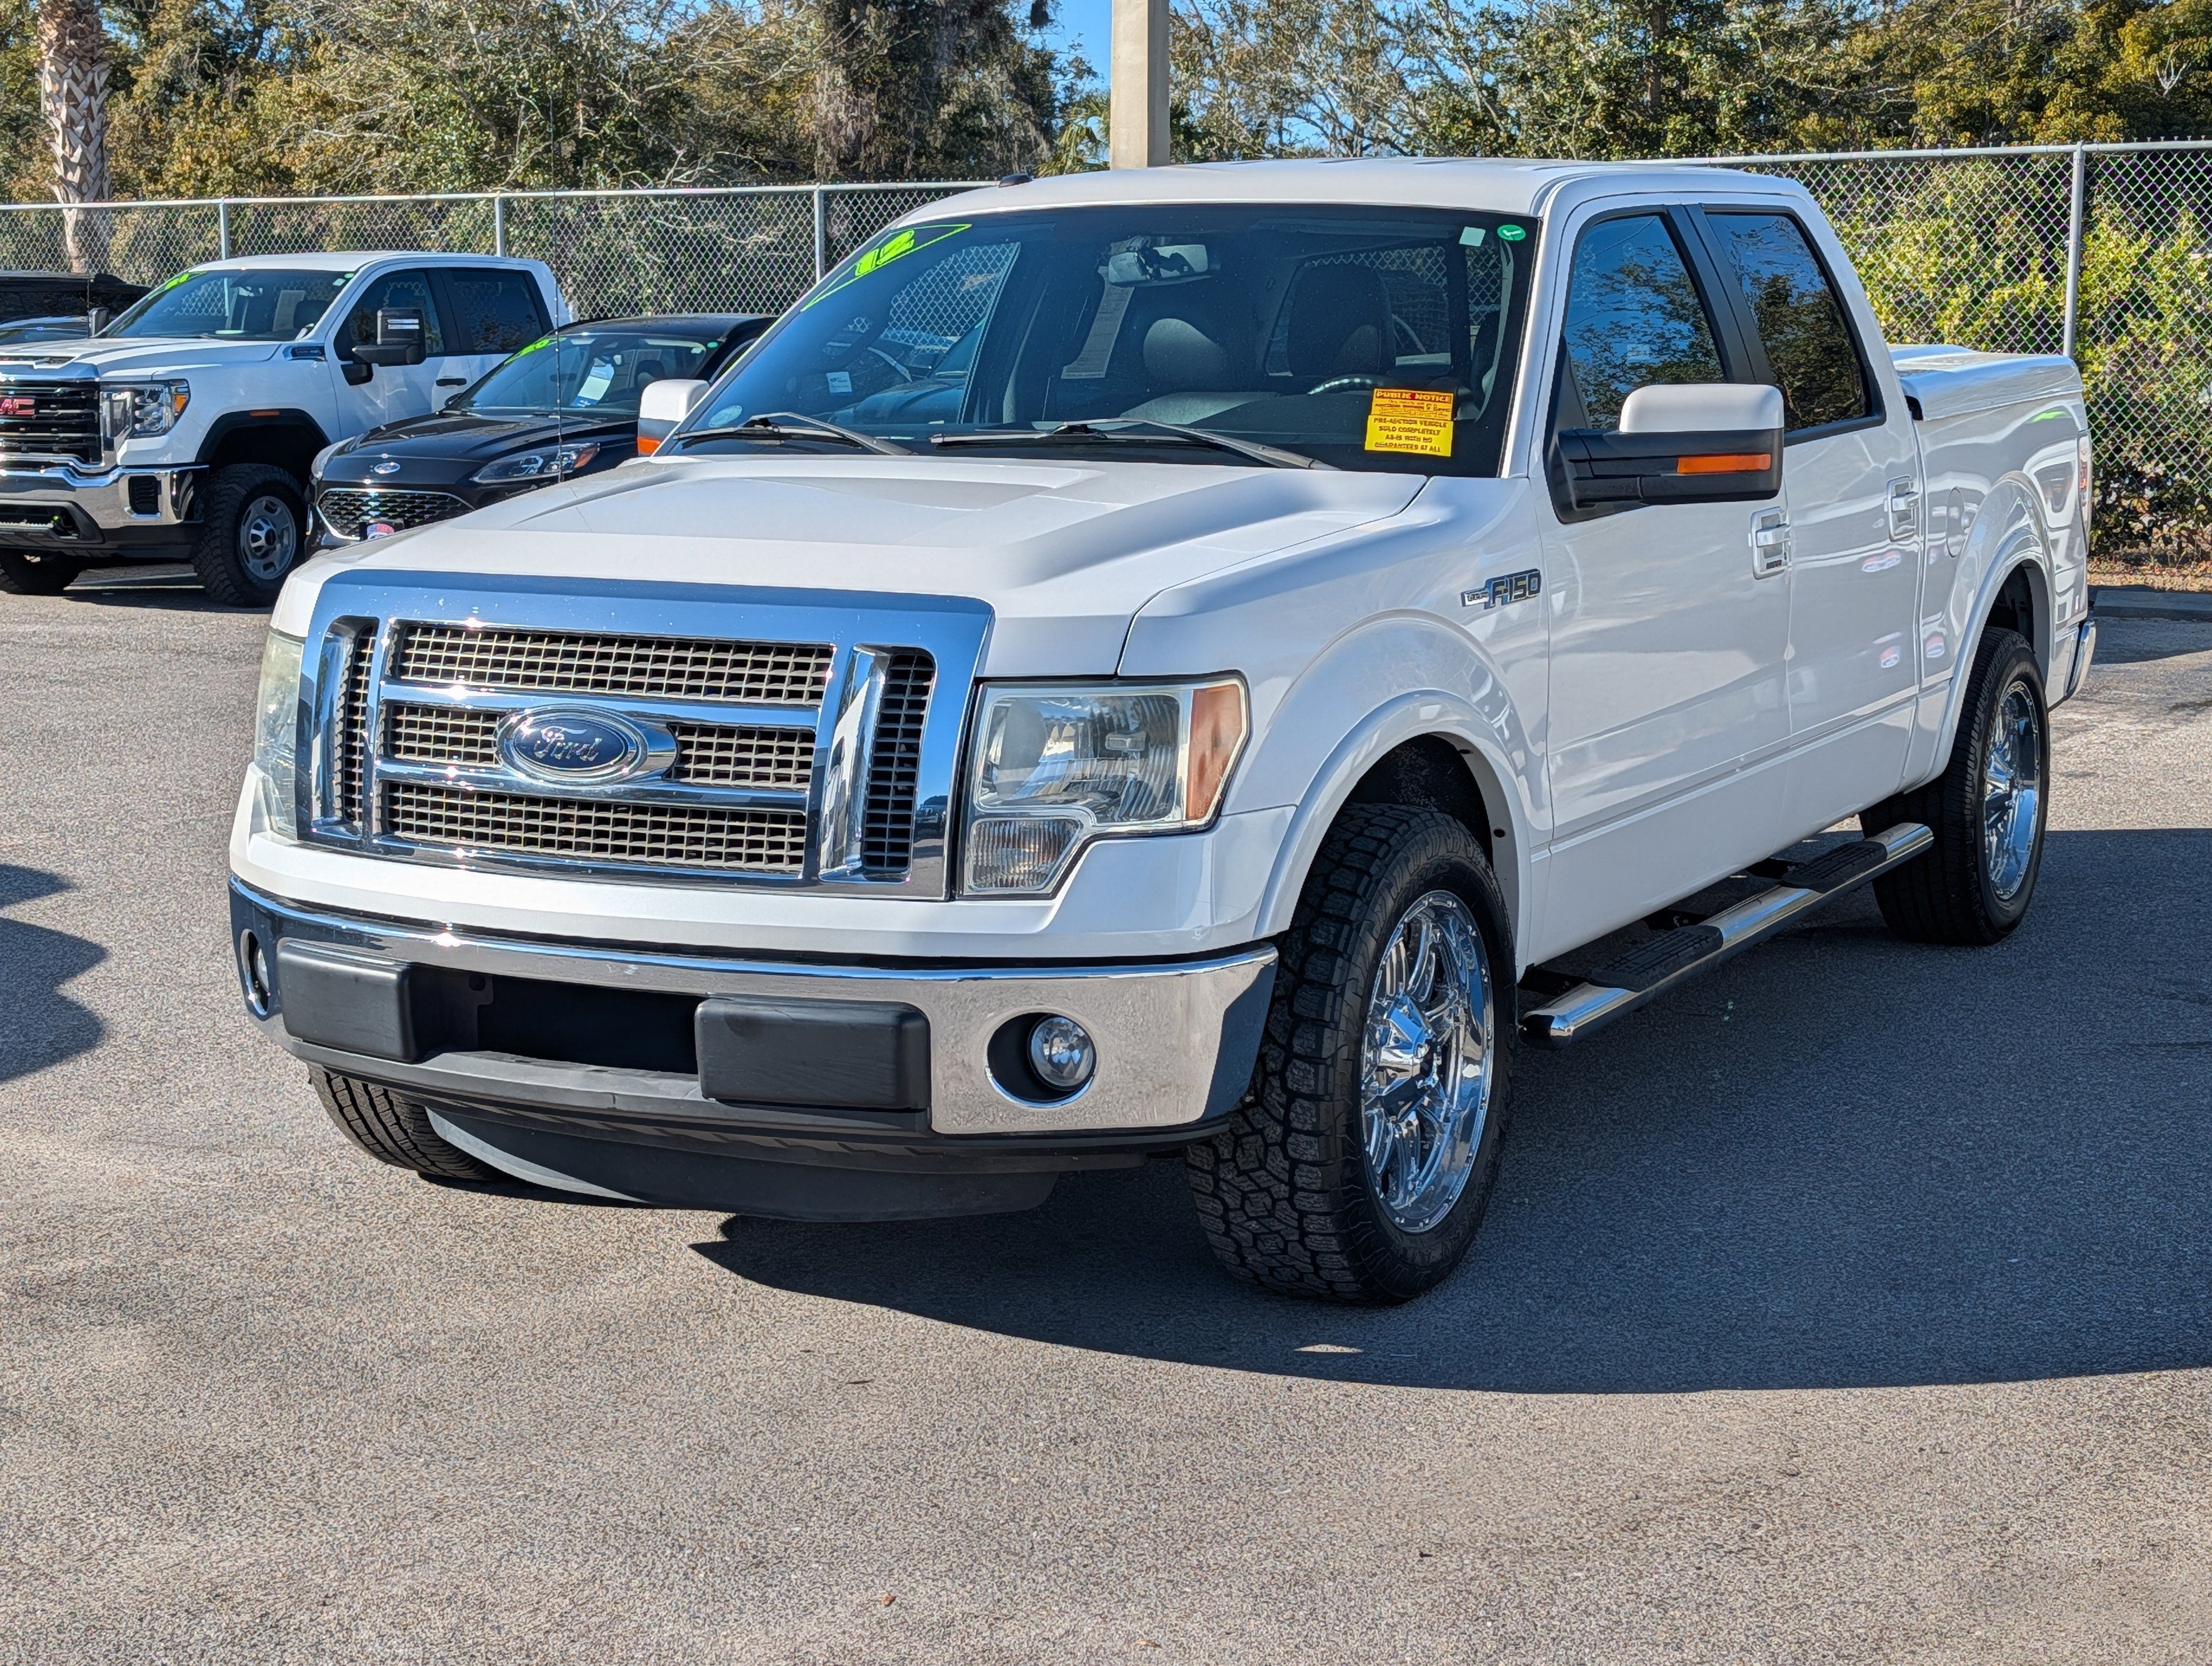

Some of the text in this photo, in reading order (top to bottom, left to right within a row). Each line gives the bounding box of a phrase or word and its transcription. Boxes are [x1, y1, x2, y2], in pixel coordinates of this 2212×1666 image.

[855, 230, 915, 276] 12
[1377, 390, 1449, 402] PUBLIC NOTICE
[1419, 420, 1448, 428] VEHICLE
[1398, 426, 1441, 435] COMPLETELY
[533, 726, 603, 761] Ford
